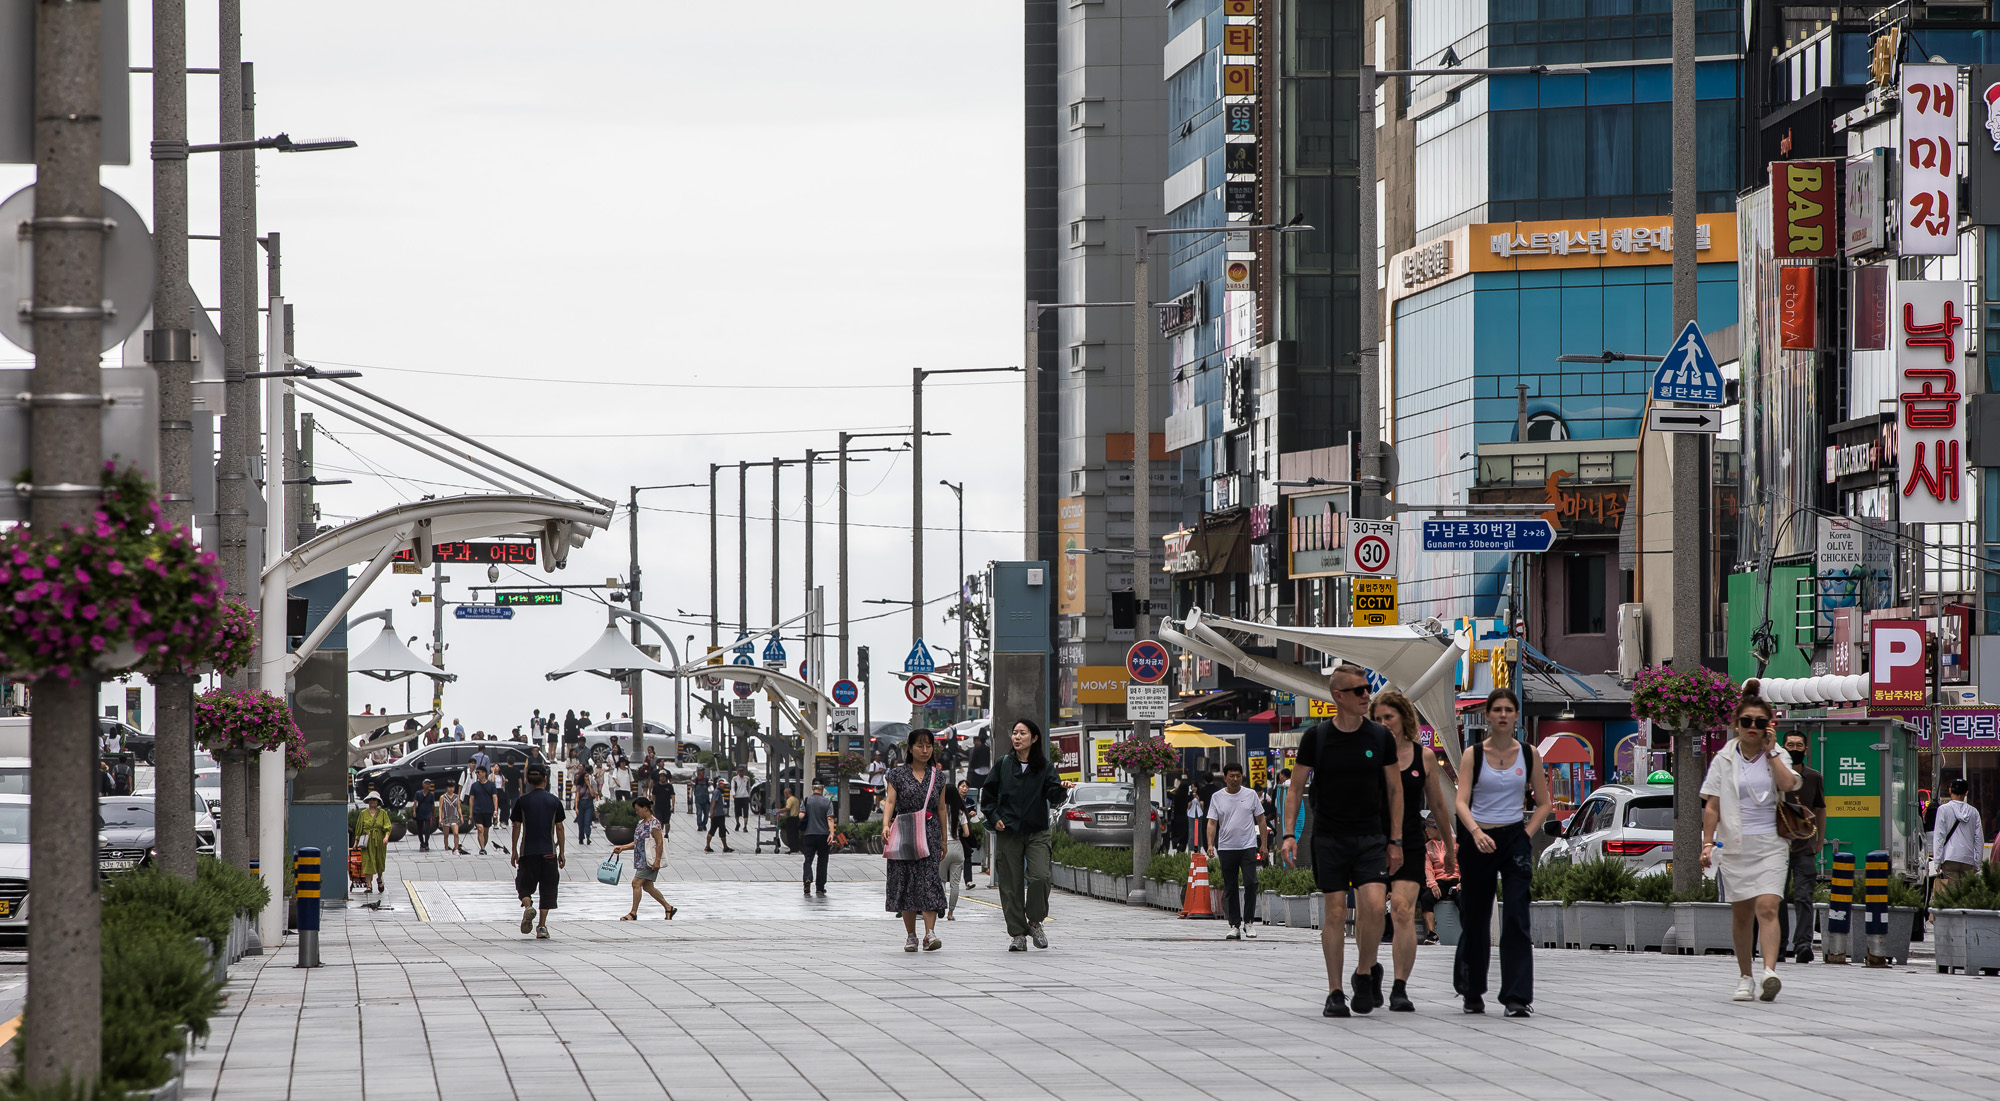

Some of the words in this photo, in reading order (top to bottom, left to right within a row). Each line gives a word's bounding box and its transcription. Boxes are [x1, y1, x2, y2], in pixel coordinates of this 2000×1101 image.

[1231, 106, 1250, 118] GS
[1231, 118, 1250, 131] 25
[1907, 82, 1954, 236] 개미집
[1787, 164, 1823, 254] BAR
[1490, 229, 1607, 257] 베스트웨스턴
[1611, 223, 1711, 253] 해운대텔
[1782, 284, 1798, 327] story
[1785, 331, 1800, 343] A
[1659, 386, 1717, 399] 횡단보도
[1900, 301, 1962, 500] 낙곱새
[1563, 492, 1629, 529] 마녀족
[1353, 522, 1393, 536] 30구역
[1829, 531, 1851, 539] Korea
[1427, 540, 1466, 548] Gunam-ro
[1469, 540, 1515, 549] 30beon-gil
[1827, 541, 1853, 550] OLIVE
[1362, 543, 1382, 563] 30
[1821, 553, 1860, 562] CHICKEN
[1358, 583, 1392, 593] 불법주정차
[1358, 597, 1391, 609] CCTV
[1132, 658, 1163, 666] 주정차금지
[1874, 628, 1922, 683] P
[1080, 680, 1117, 690] MOM'S
[1874, 690, 1923, 701] 동남주차장
[1912, 716, 2000, 741] 사주타로
[1839, 757, 1866, 770] 모노
[1251, 758, 1266, 786] 포장
[1839, 773, 1866, 786] 마트
